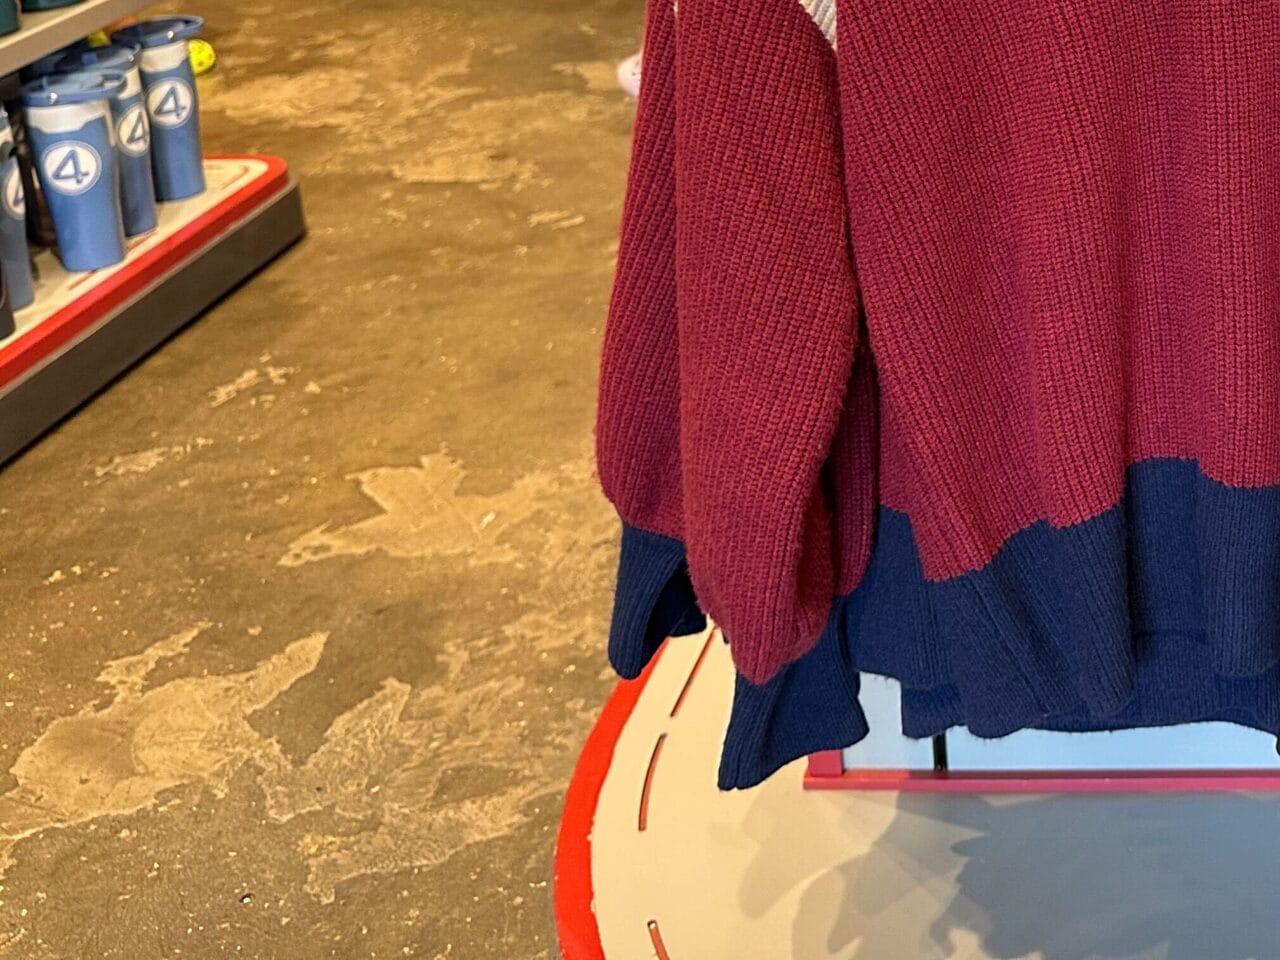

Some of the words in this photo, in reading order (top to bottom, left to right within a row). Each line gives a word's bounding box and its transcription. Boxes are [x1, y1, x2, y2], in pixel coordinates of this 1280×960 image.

[154, 86, 187, 119] 4
[126, 112, 148, 145] 4
[52, 149, 90, 184] 4
